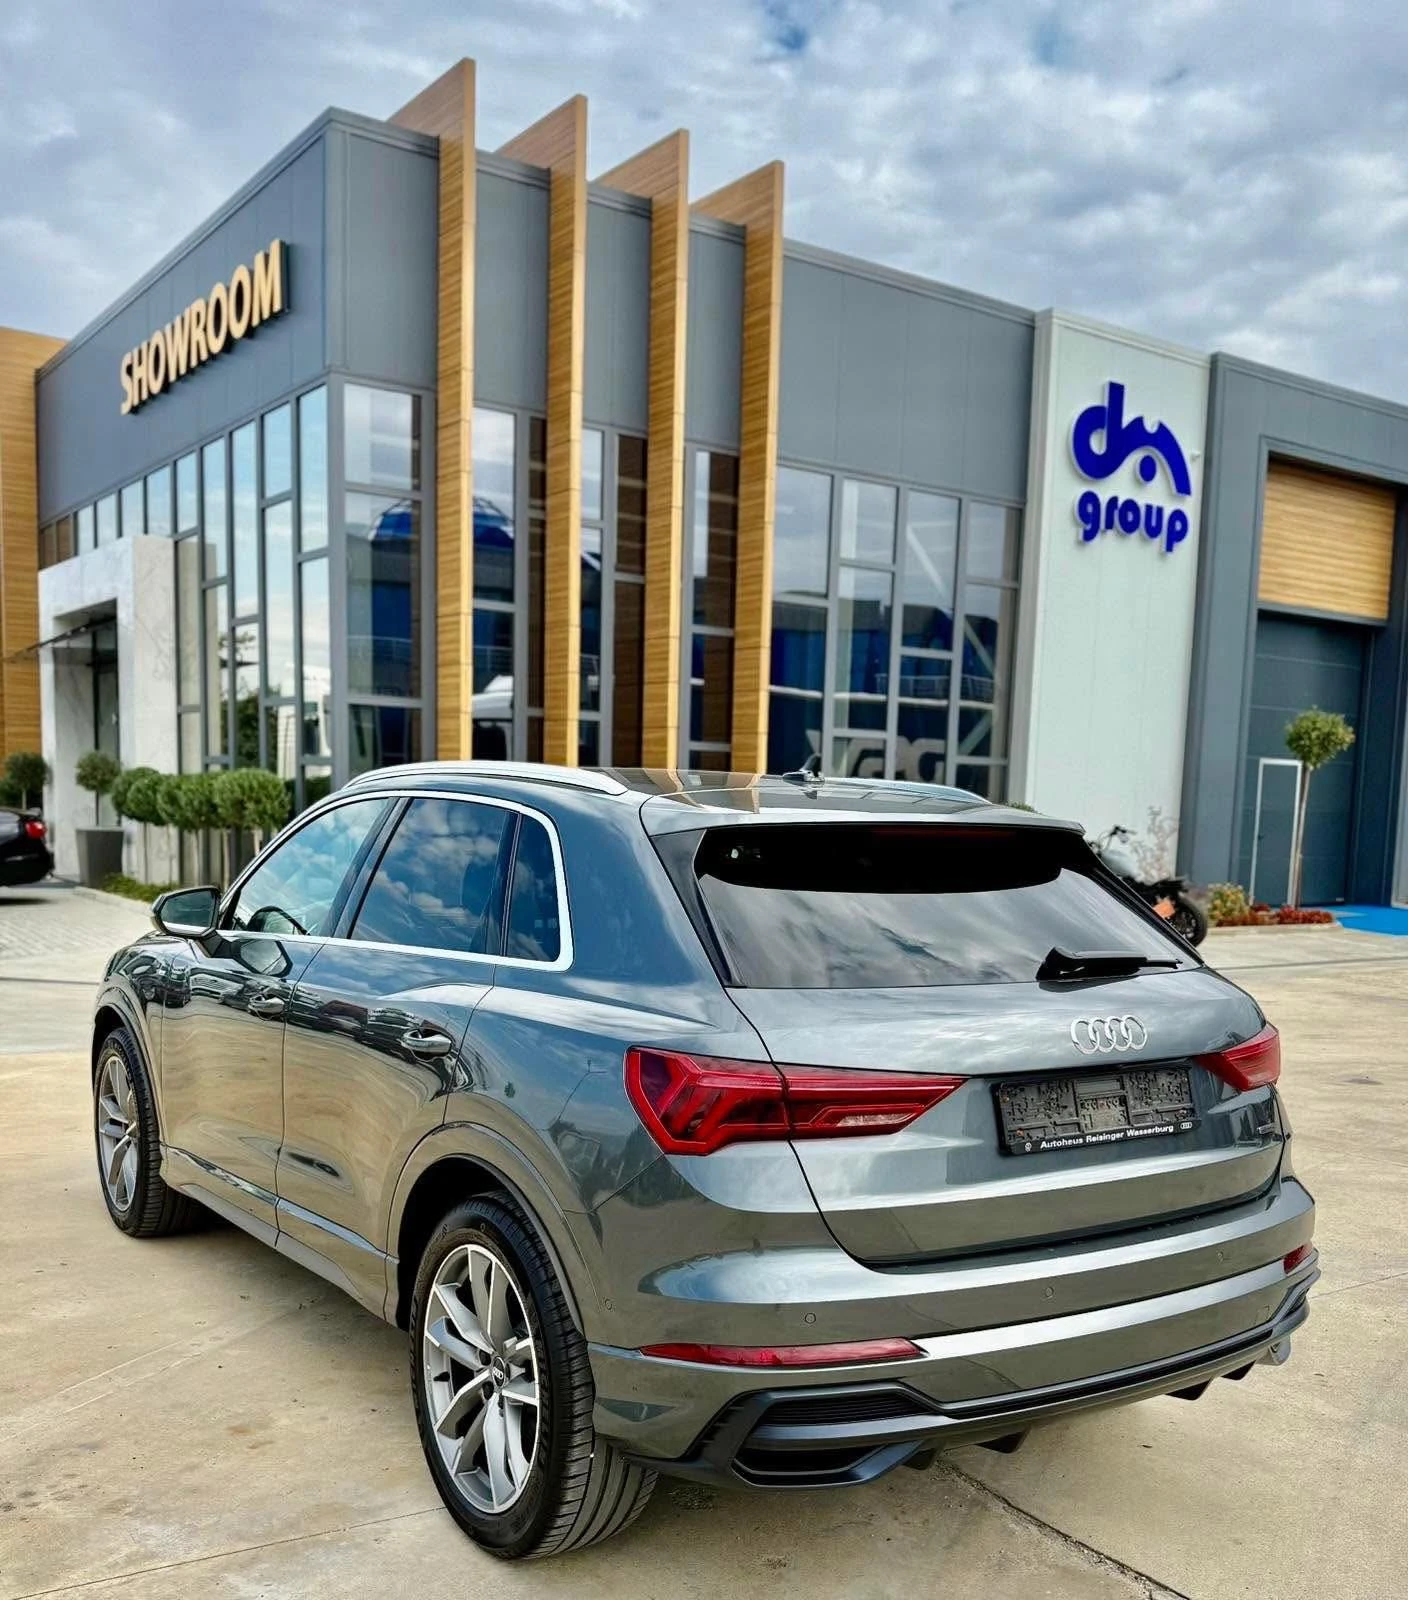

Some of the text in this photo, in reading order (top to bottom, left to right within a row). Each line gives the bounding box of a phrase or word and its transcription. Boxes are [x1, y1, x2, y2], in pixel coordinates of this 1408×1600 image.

[120, 239, 284, 416] SHOWROOM
[1077, 491, 1189, 553] group
[1086, 1131, 1125, 1143] Reisinger
[1126, 1124, 1174, 1137] Wasserburg
